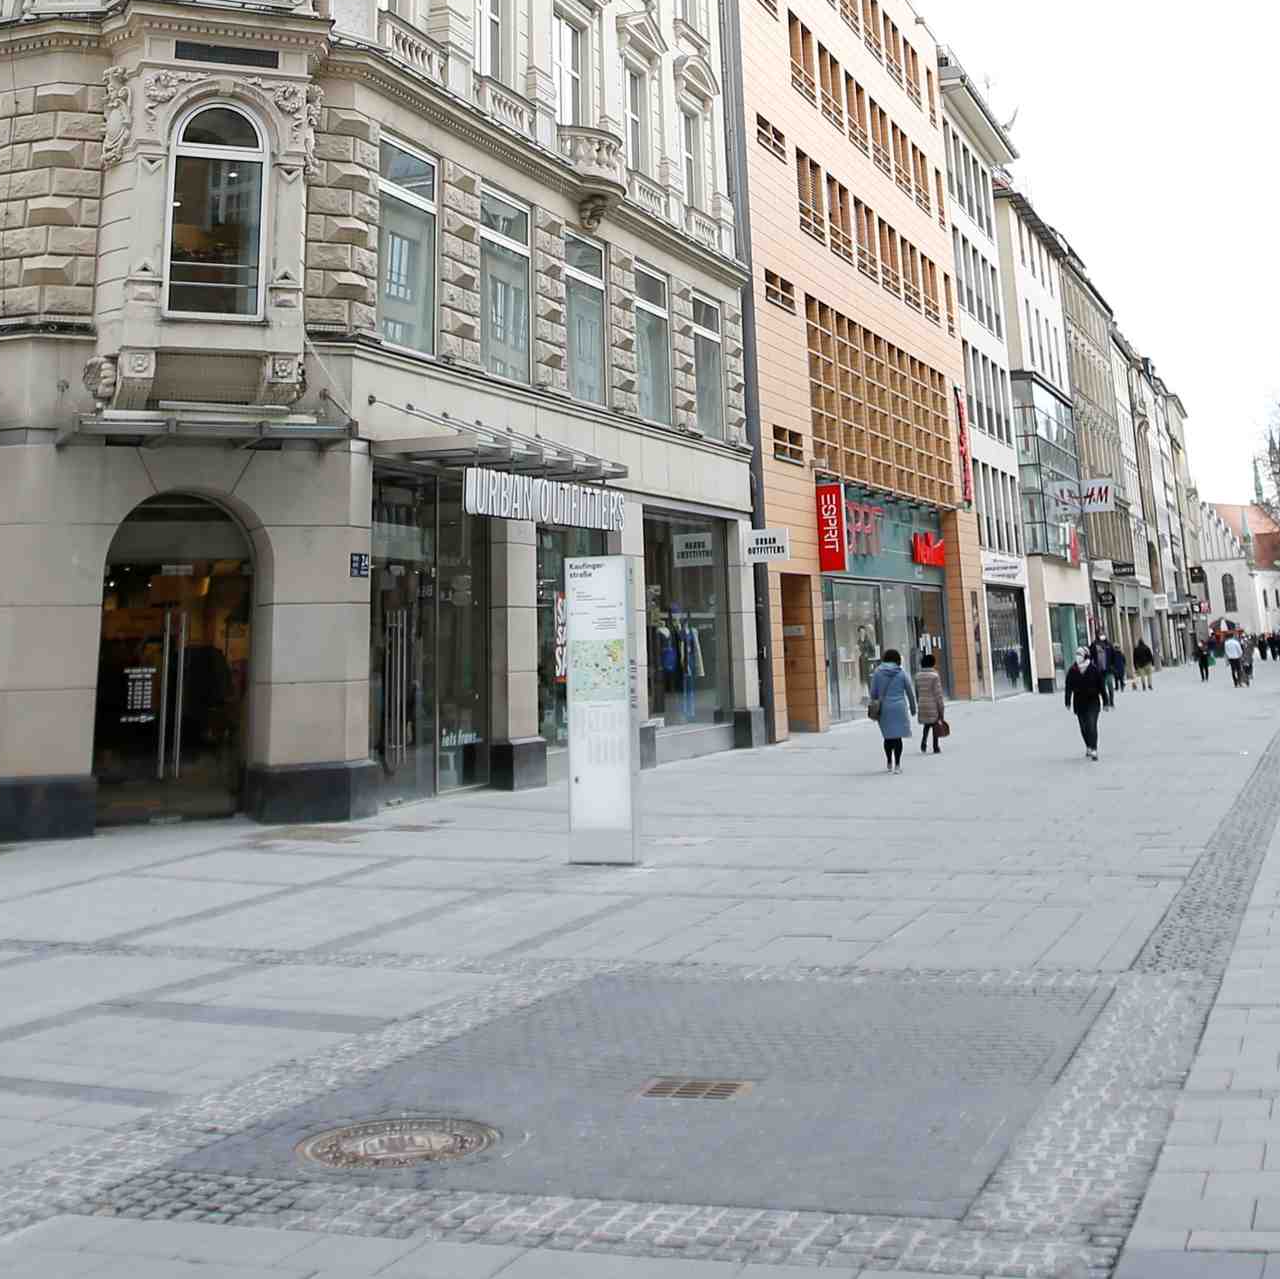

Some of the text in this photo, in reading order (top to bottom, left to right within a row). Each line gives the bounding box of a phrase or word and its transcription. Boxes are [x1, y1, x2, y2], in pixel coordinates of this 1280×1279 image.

[469, 467, 625, 531] URBAN OUTFITTERS
[820, 493, 839, 553] ESPRIT
[748, 545, 785, 555] OUTFITTERS
[755, 537, 776, 546] URBAN
